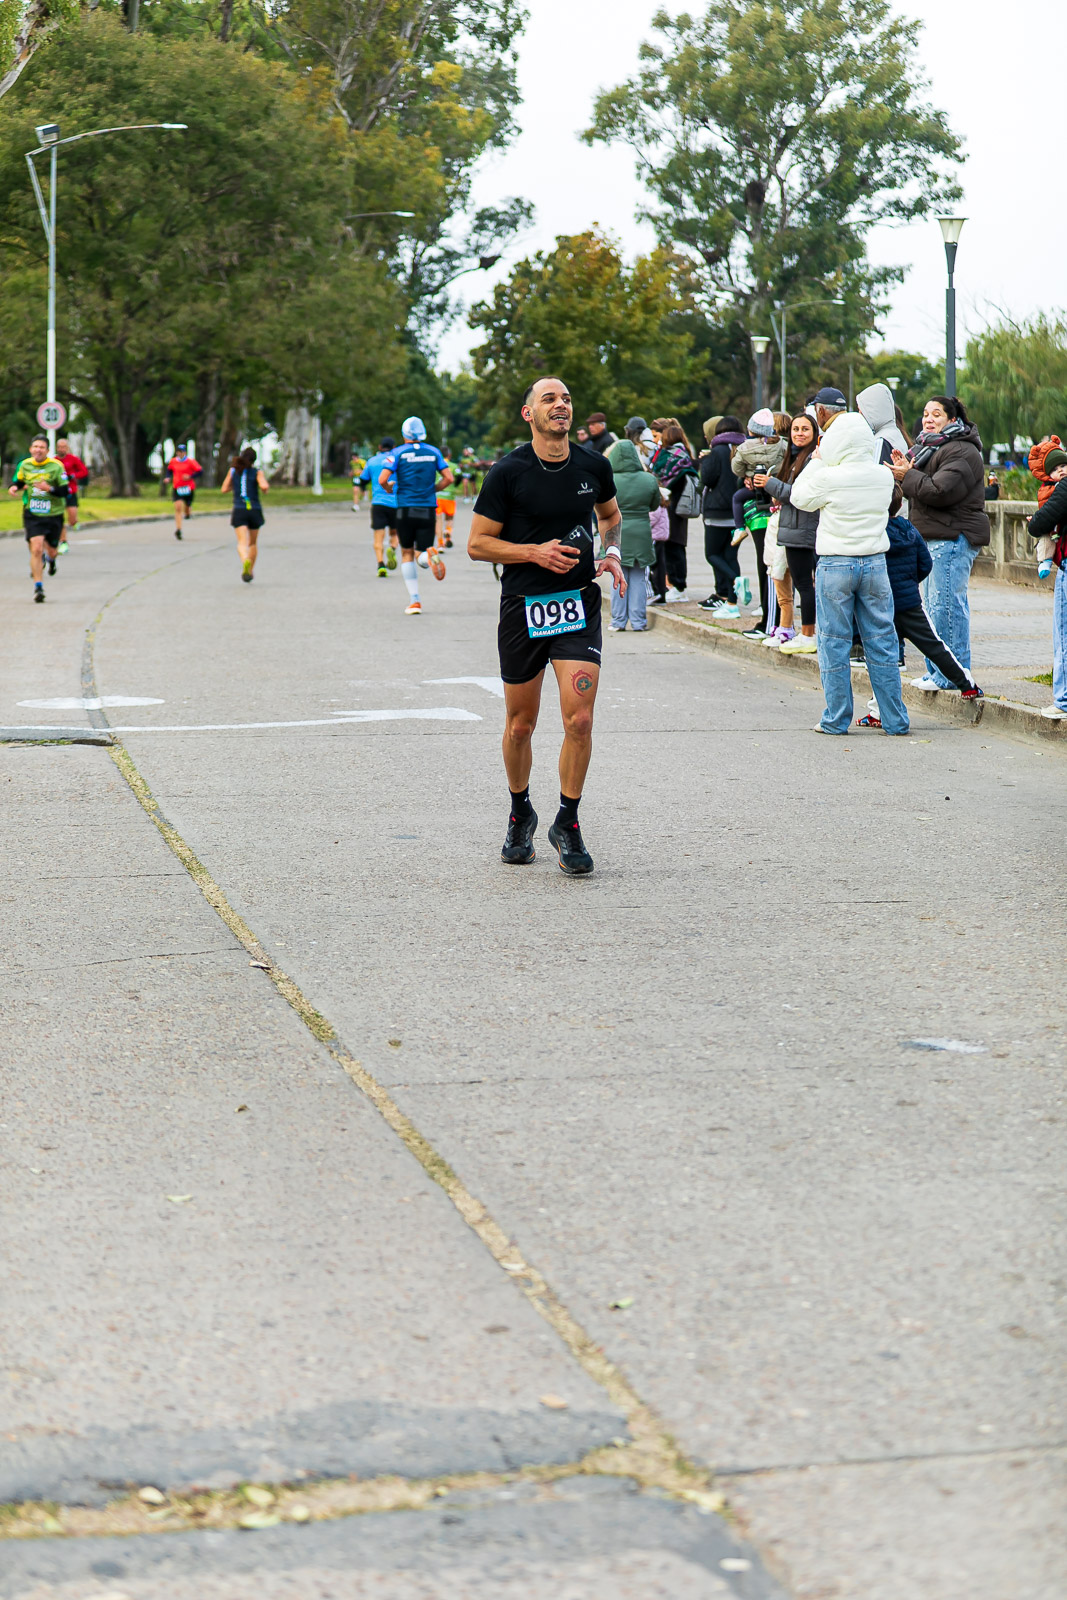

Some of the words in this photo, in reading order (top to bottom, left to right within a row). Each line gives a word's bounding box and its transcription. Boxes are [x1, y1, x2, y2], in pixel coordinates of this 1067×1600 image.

[530, 598, 579, 629] 098
[532, 628, 562, 636] DIAMANTE
[563, 623, 583, 631] CORRE
